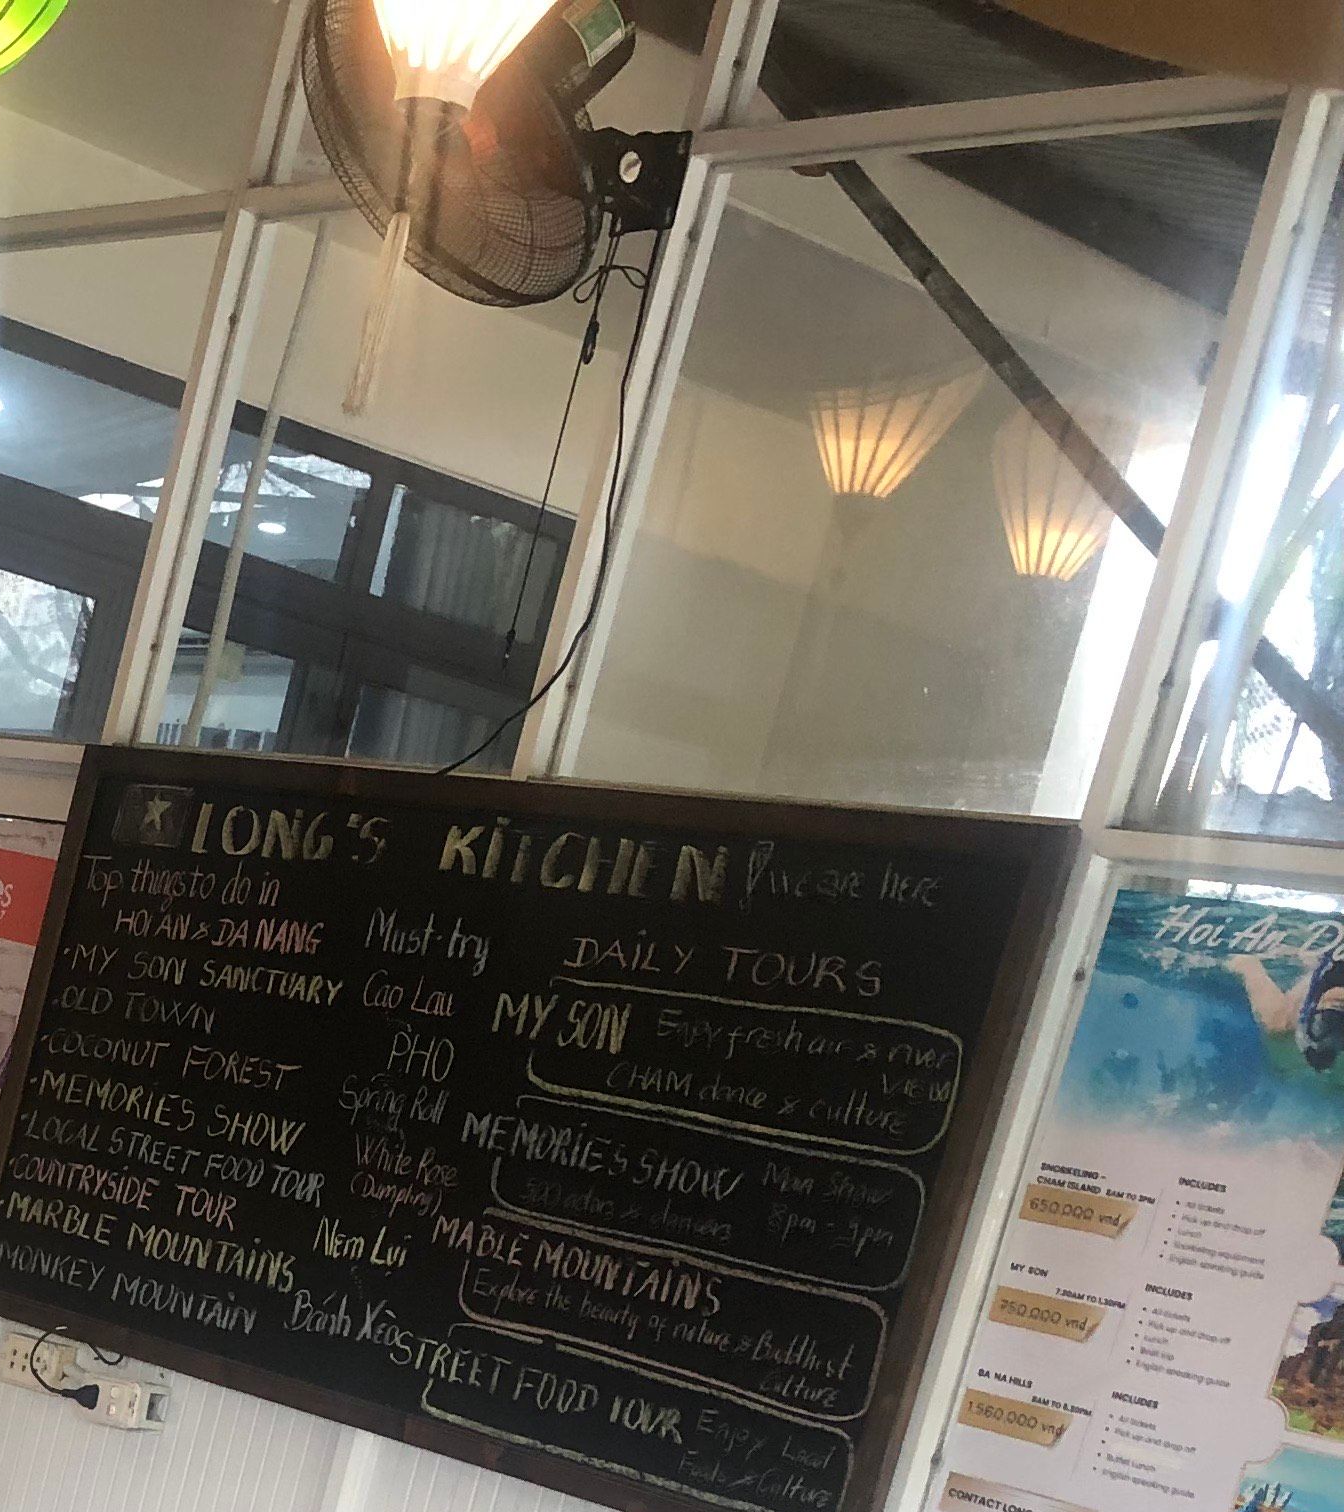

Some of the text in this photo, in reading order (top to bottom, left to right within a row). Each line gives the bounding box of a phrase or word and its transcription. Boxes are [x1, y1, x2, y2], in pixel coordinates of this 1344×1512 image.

[83, 854, 124, 909] Top
[188, 865, 216, 900] to
[221, 860, 252, 907] do
[258, 872, 281, 908] in
[157, 912, 193, 942] AN
[212, 917, 248, 949] DA
[254, 917, 325, 955] NANG
[1153, 904, 1233, 947] Hoi
[71, 943, 344, 1006] MY SON SANCTUARY
[363, 969, 404, 1009] Cao
[562, 929, 883, 998] DAILY TOURS
[60, 984, 217, 1035] OLD TOWN
[491, 992, 632, 1055] MY SON
[48, 1028, 303, 1091] COCONUT FOREST
[38, 1068, 308, 1156] MEMORIES SHOW
[25, 1109, 327, 1208] LOCAL STREET FOOD TOUR
[632, 1148, 744, 1202] SHOW
[1178, 1176, 1228, 1193] INCLUDES
[12, 1152, 238, 1232] COUNTRYSIDE TOUR
[6, 1190, 118, 1246] MARBLE
[126, 1222, 297, 1294] MOUNTAINS
[533, 1240, 723, 1318] MOUNTAINS
[1010, 1262, 1050, 1278] MY SON
[1144, 1282, 1194, 1301] INCLUDES
[111, 1272, 258, 1335] MOUNTAIN
[512, 1366, 599, 1415] FOOD
[977, 1367, 1034, 1389] BA NA HILLS
[1112, 1389, 1160, 1410] INCLUDES
[948, 1486, 1004, 1511] CONTACT
